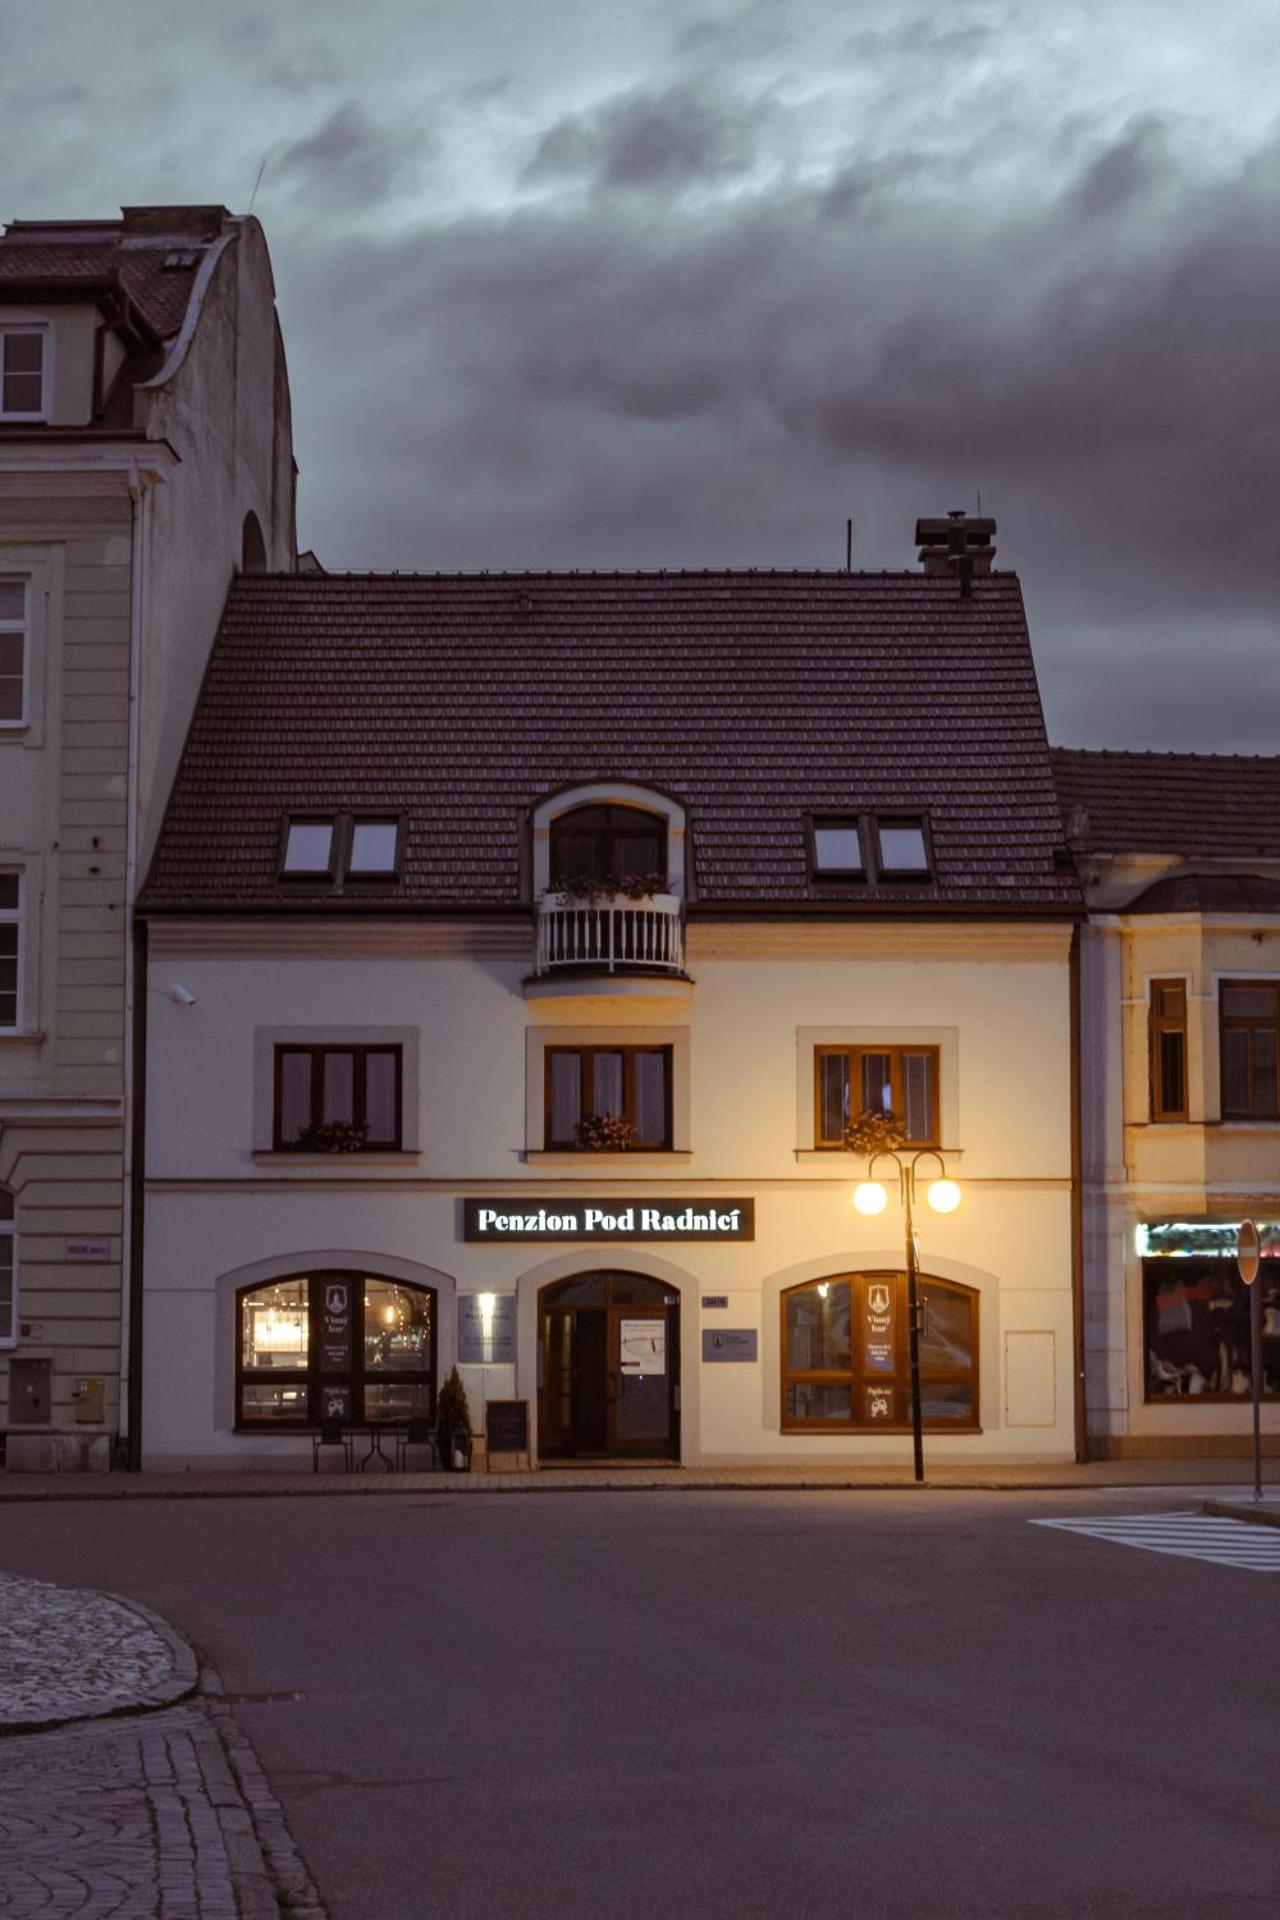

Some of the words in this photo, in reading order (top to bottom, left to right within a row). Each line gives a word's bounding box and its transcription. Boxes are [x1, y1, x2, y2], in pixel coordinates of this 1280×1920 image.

[478, 1209, 578, 1231] Penzion
[584, 1208, 635, 1231] Pod
[641, 1208, 741, 1231] Radnicí
